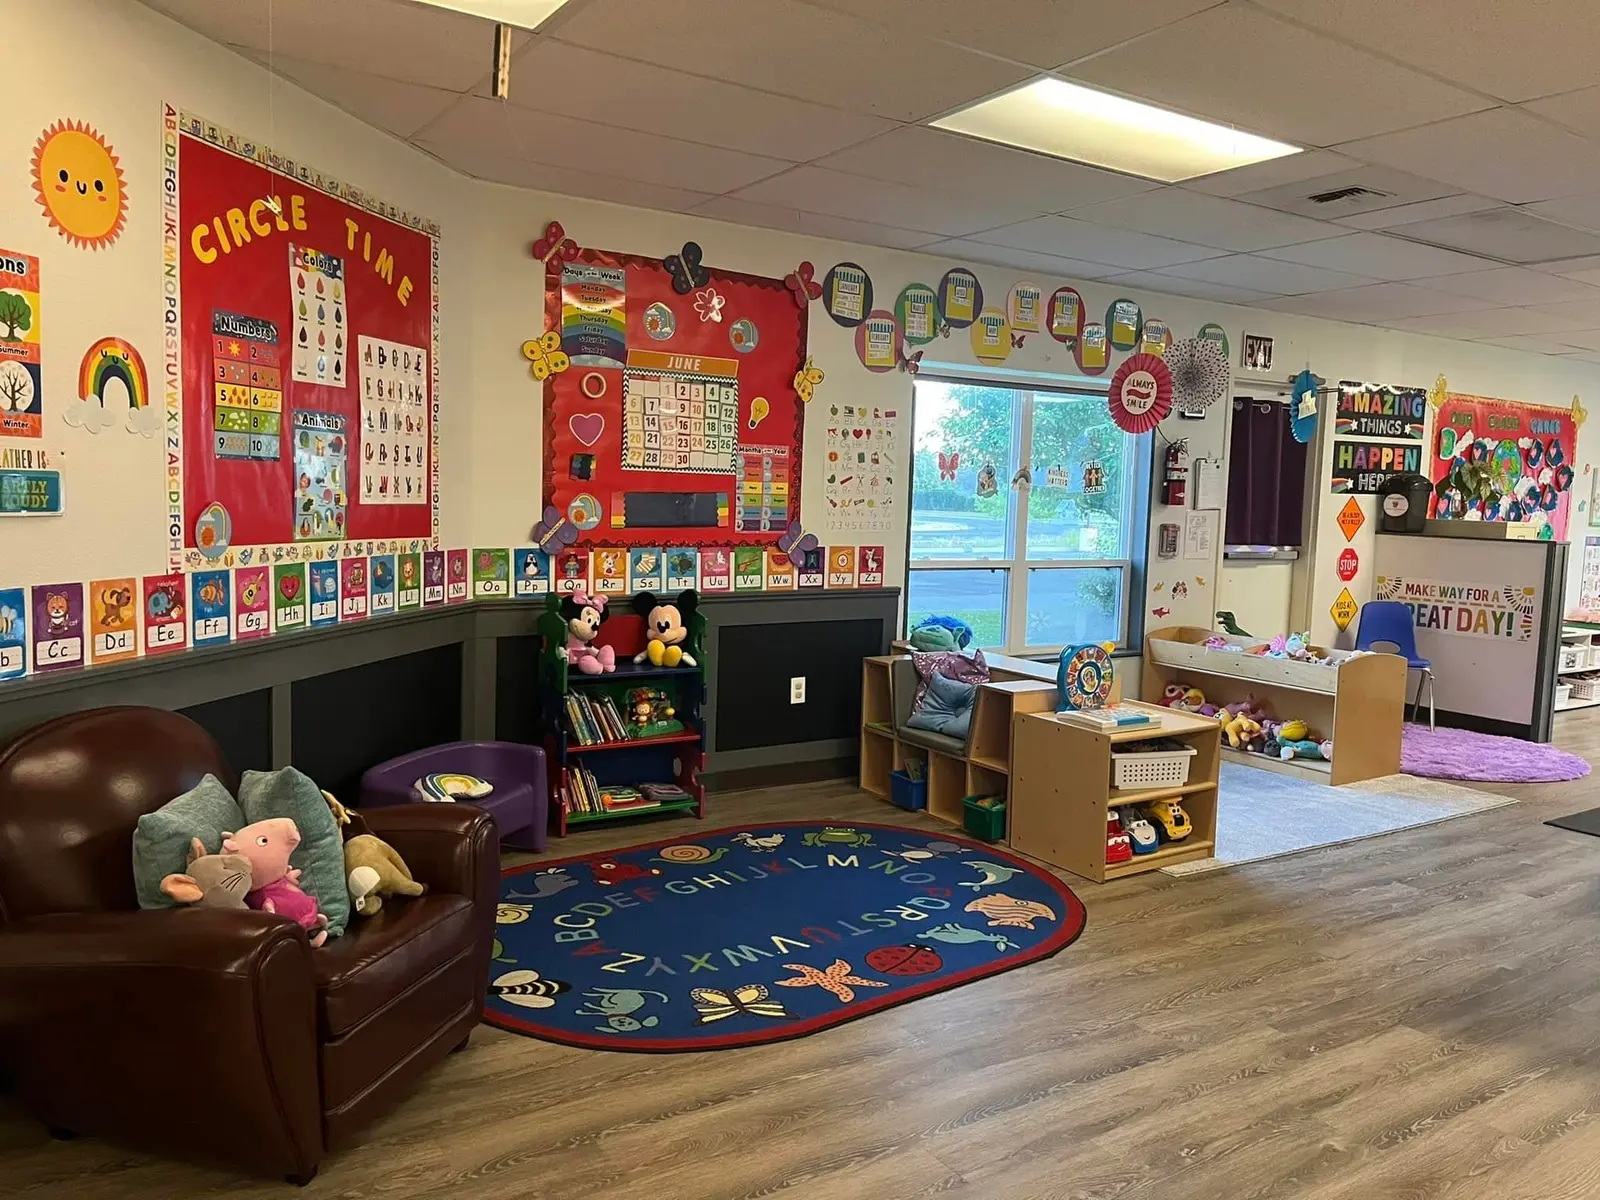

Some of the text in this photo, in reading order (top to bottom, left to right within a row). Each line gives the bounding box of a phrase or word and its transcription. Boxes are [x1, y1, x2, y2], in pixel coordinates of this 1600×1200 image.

[192, 195, 414, 307] CIRCLE TIME
[302, 253, 335, 274] Colors
[564, 267, 583, 278] Days
[601, 271, 621, 280] Week
[581, 284, 606, 293] Monday
[581, 294, 606, 303] Tuesday
[579, 314, 608, 324] Thursday
[221, 316, 271, 339] Numbers
[584, 325, 603, 334] Friday
[218, 341, 223, 352] 1
[252, 347, 257, 358] 2
[1246, 338, 1272, 366] EXIT
[667, 356, 701, 371] JUNE
[219, 366, 225, 377] 3
[252, 371, 258, 382] 4
[1127, 378, 1155, 390] ALWAYS
[221, 390, 226, 401] 5
[253, 394, 258, 405] 6
[665, 385, 730, 400] 1 2 3 4 5
[630, 398, 733, 419] 6 7 8 9 10 11 12
[1126, 397, 1147, 409] SMILE
[1340, 391, 1424, 418] AMAZING
[3, 419, 29, 429] Winter
[220, 414, 225, 425] 7
[253, 417, 258, 428] 8
[302, 413, 339, 430] Animals
[630, 416, 732, 434] 13 14 15 16 17 18 19
[1360, 418, 1402, 435] THINGS
[219, 437, 225, 448] 9
[252, 440, 262, 451] 10
[630, 433, 731, 450] 20 21 22 23 24 25 26
[0, 449, 33, 469] ATHER
[630, 450, 688, 464] 27 28 29 30
[1338, 445, 1418, 472] HAPPEN
[2, 478, 49, 493] ARTLY
[1340, 559, 1357, 571] STOP
[602, 579, 616, 589] Rr
[640, 578, 653, 588] Ss
[675, 577, 688, 587] Tt
[709, 576, 723, 586] Uu
[742, 575, 755, 585] Vv
[772, 575, 789, 585] Ww
[805, 575, 818, 584] Xx
[835, 574, 847, 585] Yy
[865, 573, 877, 582] Zz
[429, 587, 440, 598] Mm
[452, 584, 462, 594] Nn
[483, 580, 500, 592] Oo
[525, 580, 538, 593] Pp
[1405, 583, 1500, 602] MAKE WAY FOR A
[377, 595, 388, 606] Kk
[405, 591, 413, 602] Ll
[319, 603, 329, 616] Ii
[349, 598, 359, 613] Jj
[1336, 600, 1346, 609] KIDS
[284, 607, 299, 621] Hh
[1337, 611, 1350, 619] WORK
[1410, 602, 1513, 637] EAT DAY!
[204, 619, 219, 635] Ff
[246, 613, 261, 630] Gg
[157, 625, 175, 641] Ee
[105, 633, 126, 651] Dd
[48, 641, 68, 658] Cc
[0, 652, 9, 668] b
[761, 860, 793, 874] K
[787, 857, 818, 869] L
[827, 853, 859, 868] M
[868, 860, 908, 875] N
[724, 870, 748, 882] I
[748, 865, 768, 879] J
[899, 872, 935, 884] O
[665, 880, 699, 895] G
[692, 873, 730, 889] H
[633, 886, 660, 902] F
[922, 887, 952, 898] P
[604, 892, 640, 909] E
[906, 896, 950, 910] Q
[570, 902, 612, 917] D
[883, 905, 928, 921] R
[554, 914, 595, 928] C
[861, 913, 896, 928] S
[801, 926, 842, 945] U
[837, 920, 872, 937] T
[555, 929, 599, 943] B
[572, 941, 617, 956] A
[771, 935, 811, 955] V
[600, 952, 646, 974] Z
[682, 952, 719, 974] X
[722, 944, 775, 968] W
[645, 956, 677, 977] Y
